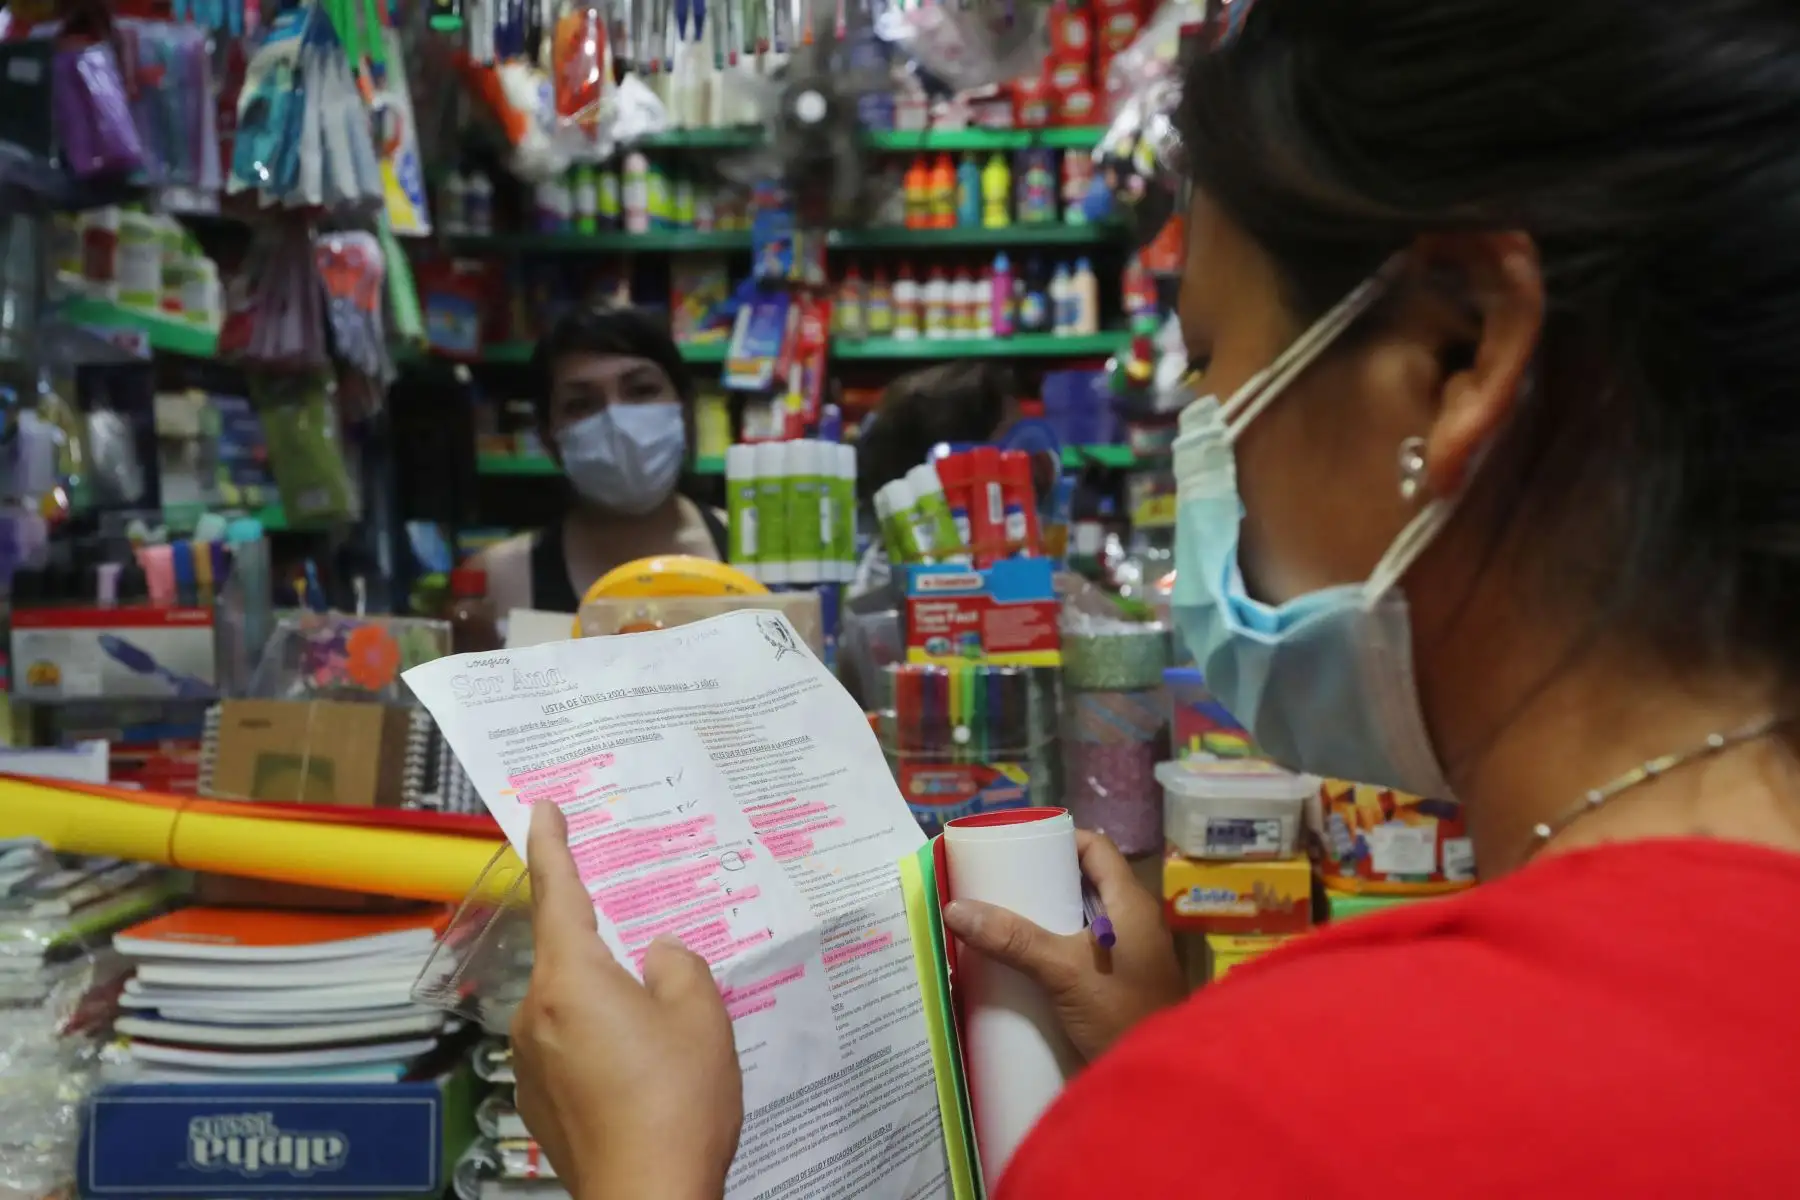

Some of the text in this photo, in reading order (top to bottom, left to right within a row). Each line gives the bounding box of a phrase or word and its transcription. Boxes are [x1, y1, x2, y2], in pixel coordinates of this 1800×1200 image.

[450, 667, 568, 700] Sor Ana
[541, 702, 566, 714] LISTA
[566, 697, 580, 709] DE
[579, 693, 607, 704] ÚTILES
[607, 688, 625, 699] 2022
[194, 1135, 344, 1170] alpha
